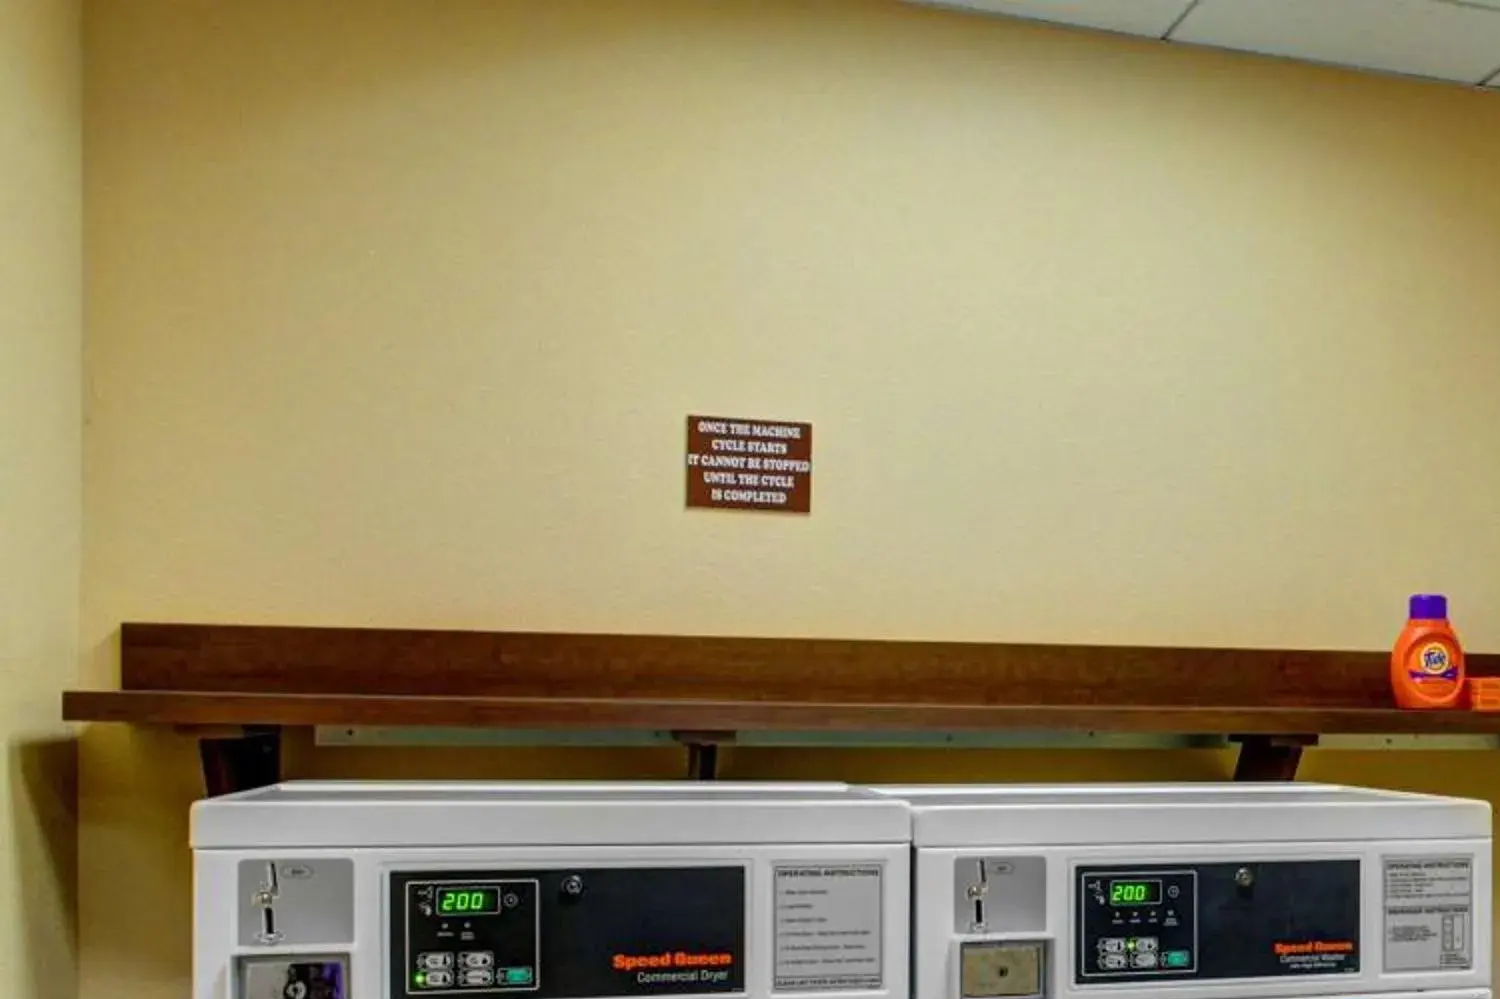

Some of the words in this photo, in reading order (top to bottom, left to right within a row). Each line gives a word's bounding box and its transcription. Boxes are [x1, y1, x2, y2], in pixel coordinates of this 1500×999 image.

[698, 420, 727, 434] ONCE
[729, 423, 750, 435] THE
[752, 424, 801, 439] MACHINE
[712, 439, 745, 452] CYCLE
[748, 441, 787, 455] STARTS
[688, 453, 699, 466] IT
[701, 454, 745, 469] CANNOT
[747, 457, 761, 470] BE
[763, 459, 810, 473] STOPPED
[703, 471, 737, 484] UNTIL
[738, 473, 760, 486] THE
[761, 475, 795, 489] CYCLE
[711, 488, 722, 501] IS
[724, 489, 787, 505] COMPLETED
[1423, 650, 1446, 669] Tide
[442, 892, 485, 911] 200
[1112, 884, 1147, 901] 200
[1275, 941, 1313, 955] Speed
[612, 951, 671, 971] Speed
[674, 951, 732, 966] Queen
[637, 970, 699, 983] Commercial
[700, 969, 729, 983] Dryer
